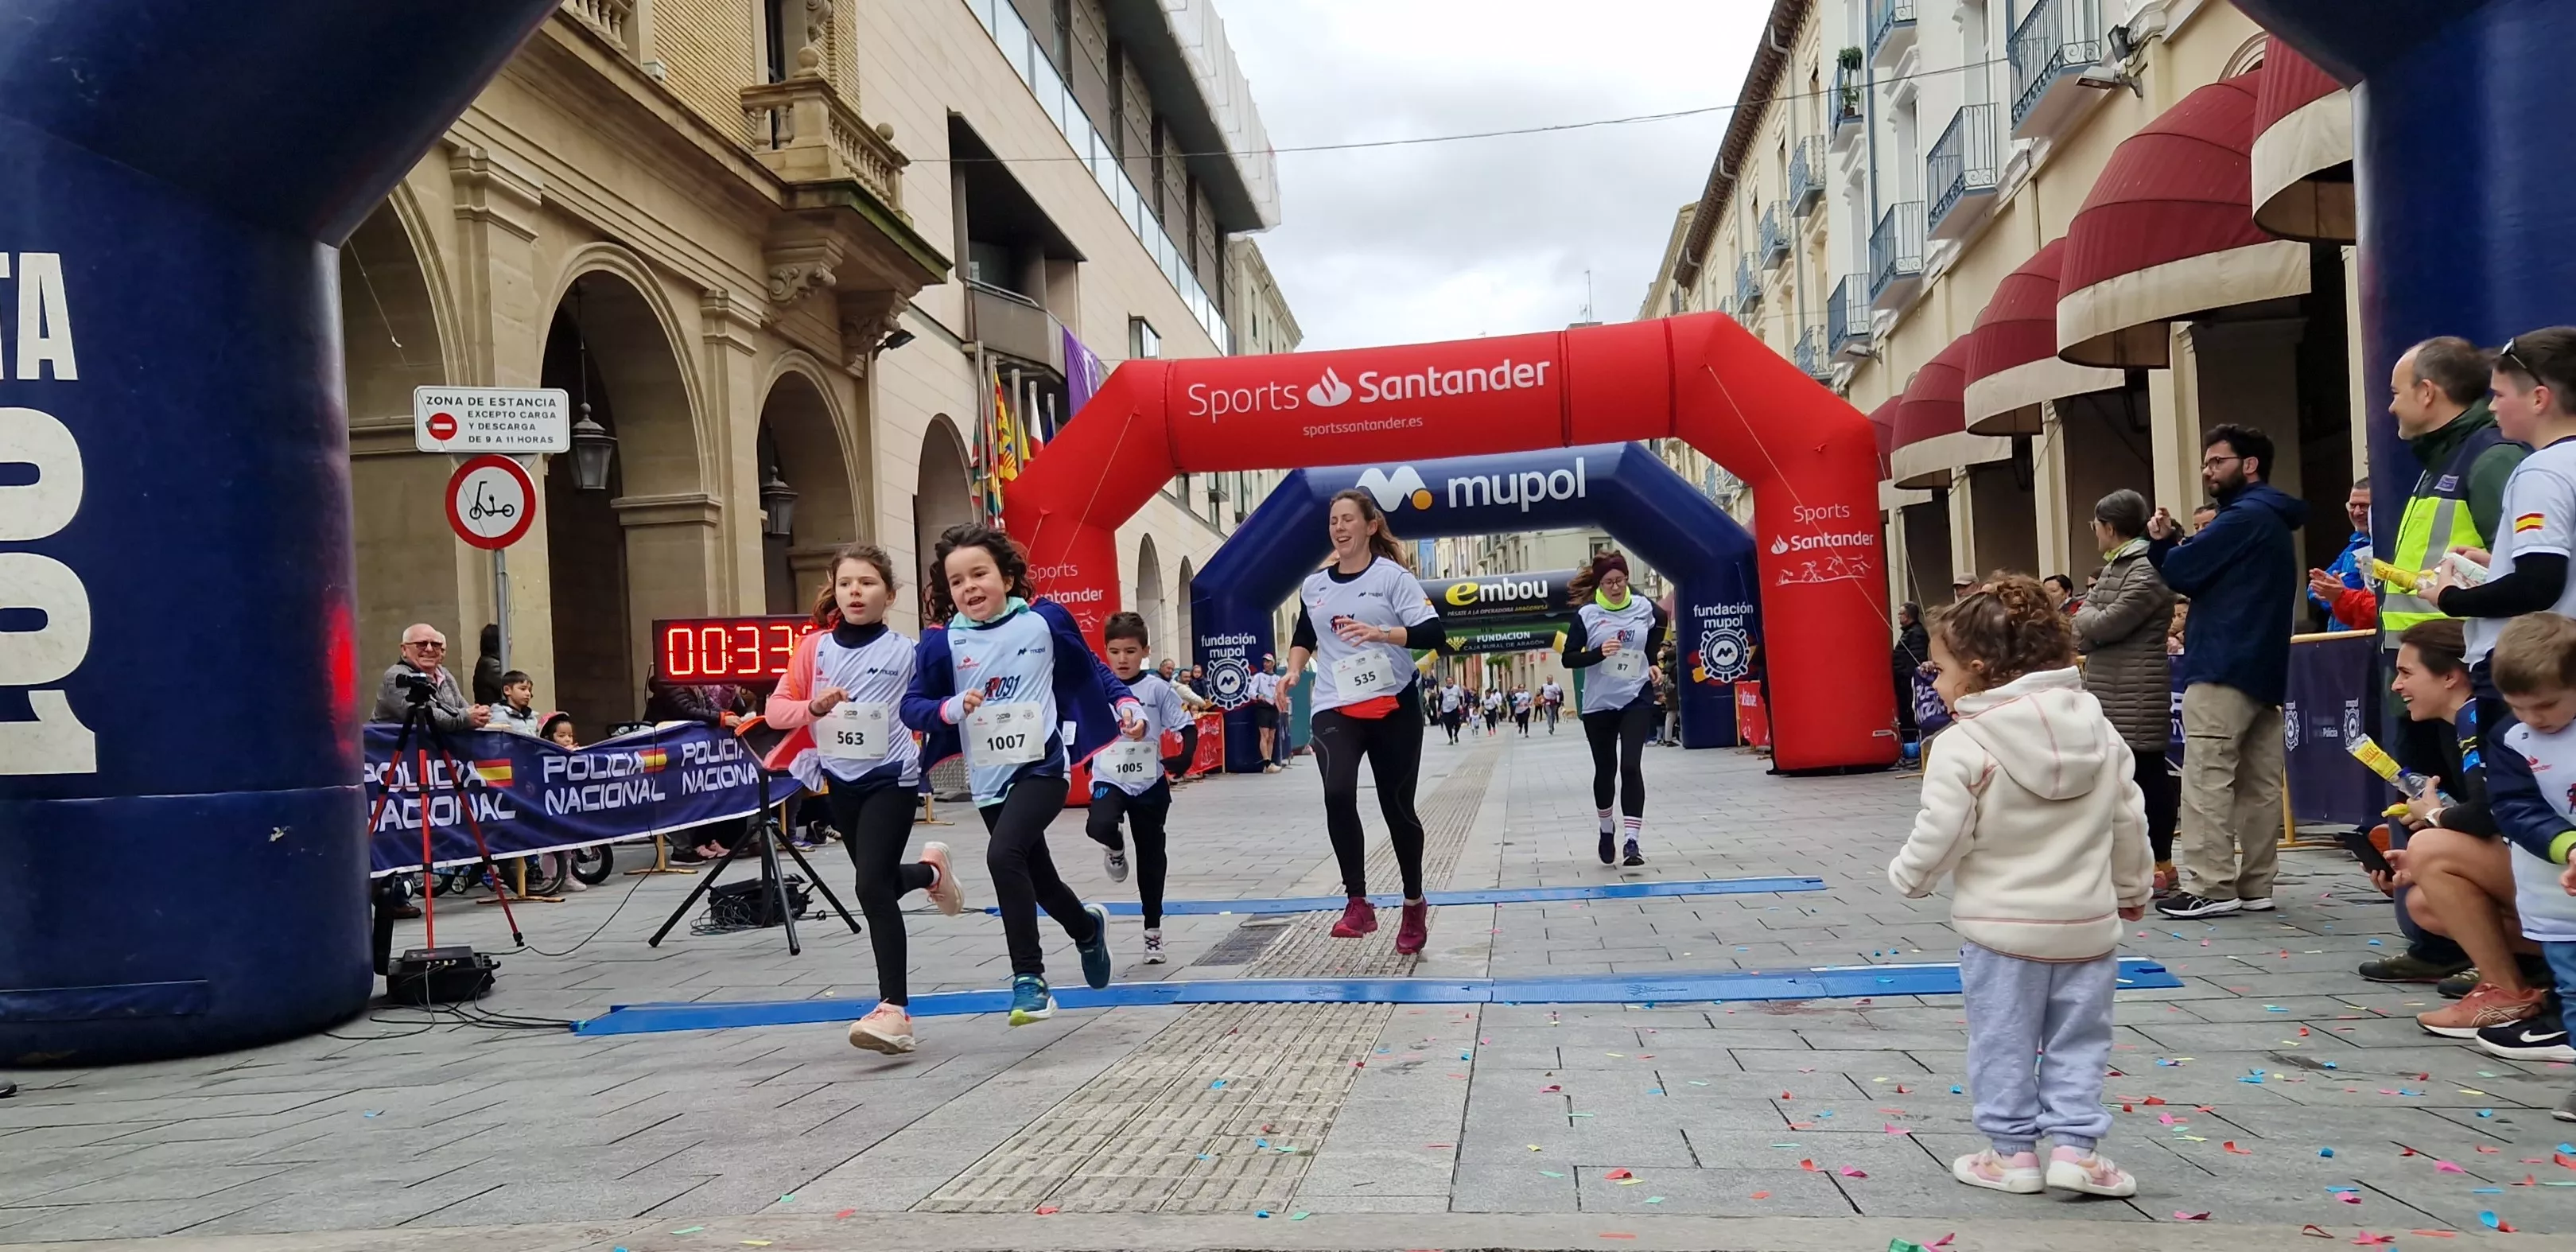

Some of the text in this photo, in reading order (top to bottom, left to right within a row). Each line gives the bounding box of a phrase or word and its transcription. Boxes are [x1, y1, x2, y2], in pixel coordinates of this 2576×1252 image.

[1188, 359, 1550, 422] Sports Santander
[426, 396, 556, 407] ZONA DE ESTANCIA
[1303, 415, 1423, 437] sportssantander.es
[1447, 457, 1586, 512] mupol
[1793, 504, 1850, 525] Sports
[1790, 531, 1874, 551] Santander
[1027, 563, 1078, 582] Sports
[1029, 588, 1104, 605] ntander
[1445, 577, 1548, 606] embou
[1693, 601, 1754, 617] fundación
[1704, 615, 1743, 629] mupol
[1201, 633, 1256, 647] fundación
[1209, 645, 1245, 659] mupol
[1354, 671, 1376, 686] 535
[837, 731, 864, 745] 563
[987, 733, 1025, 751] 1007
[1116, 763, 1143, 773] 1005
[682, 762, 760, 795] NACIONA
[545, 777, 666, 816] NACIONAL
